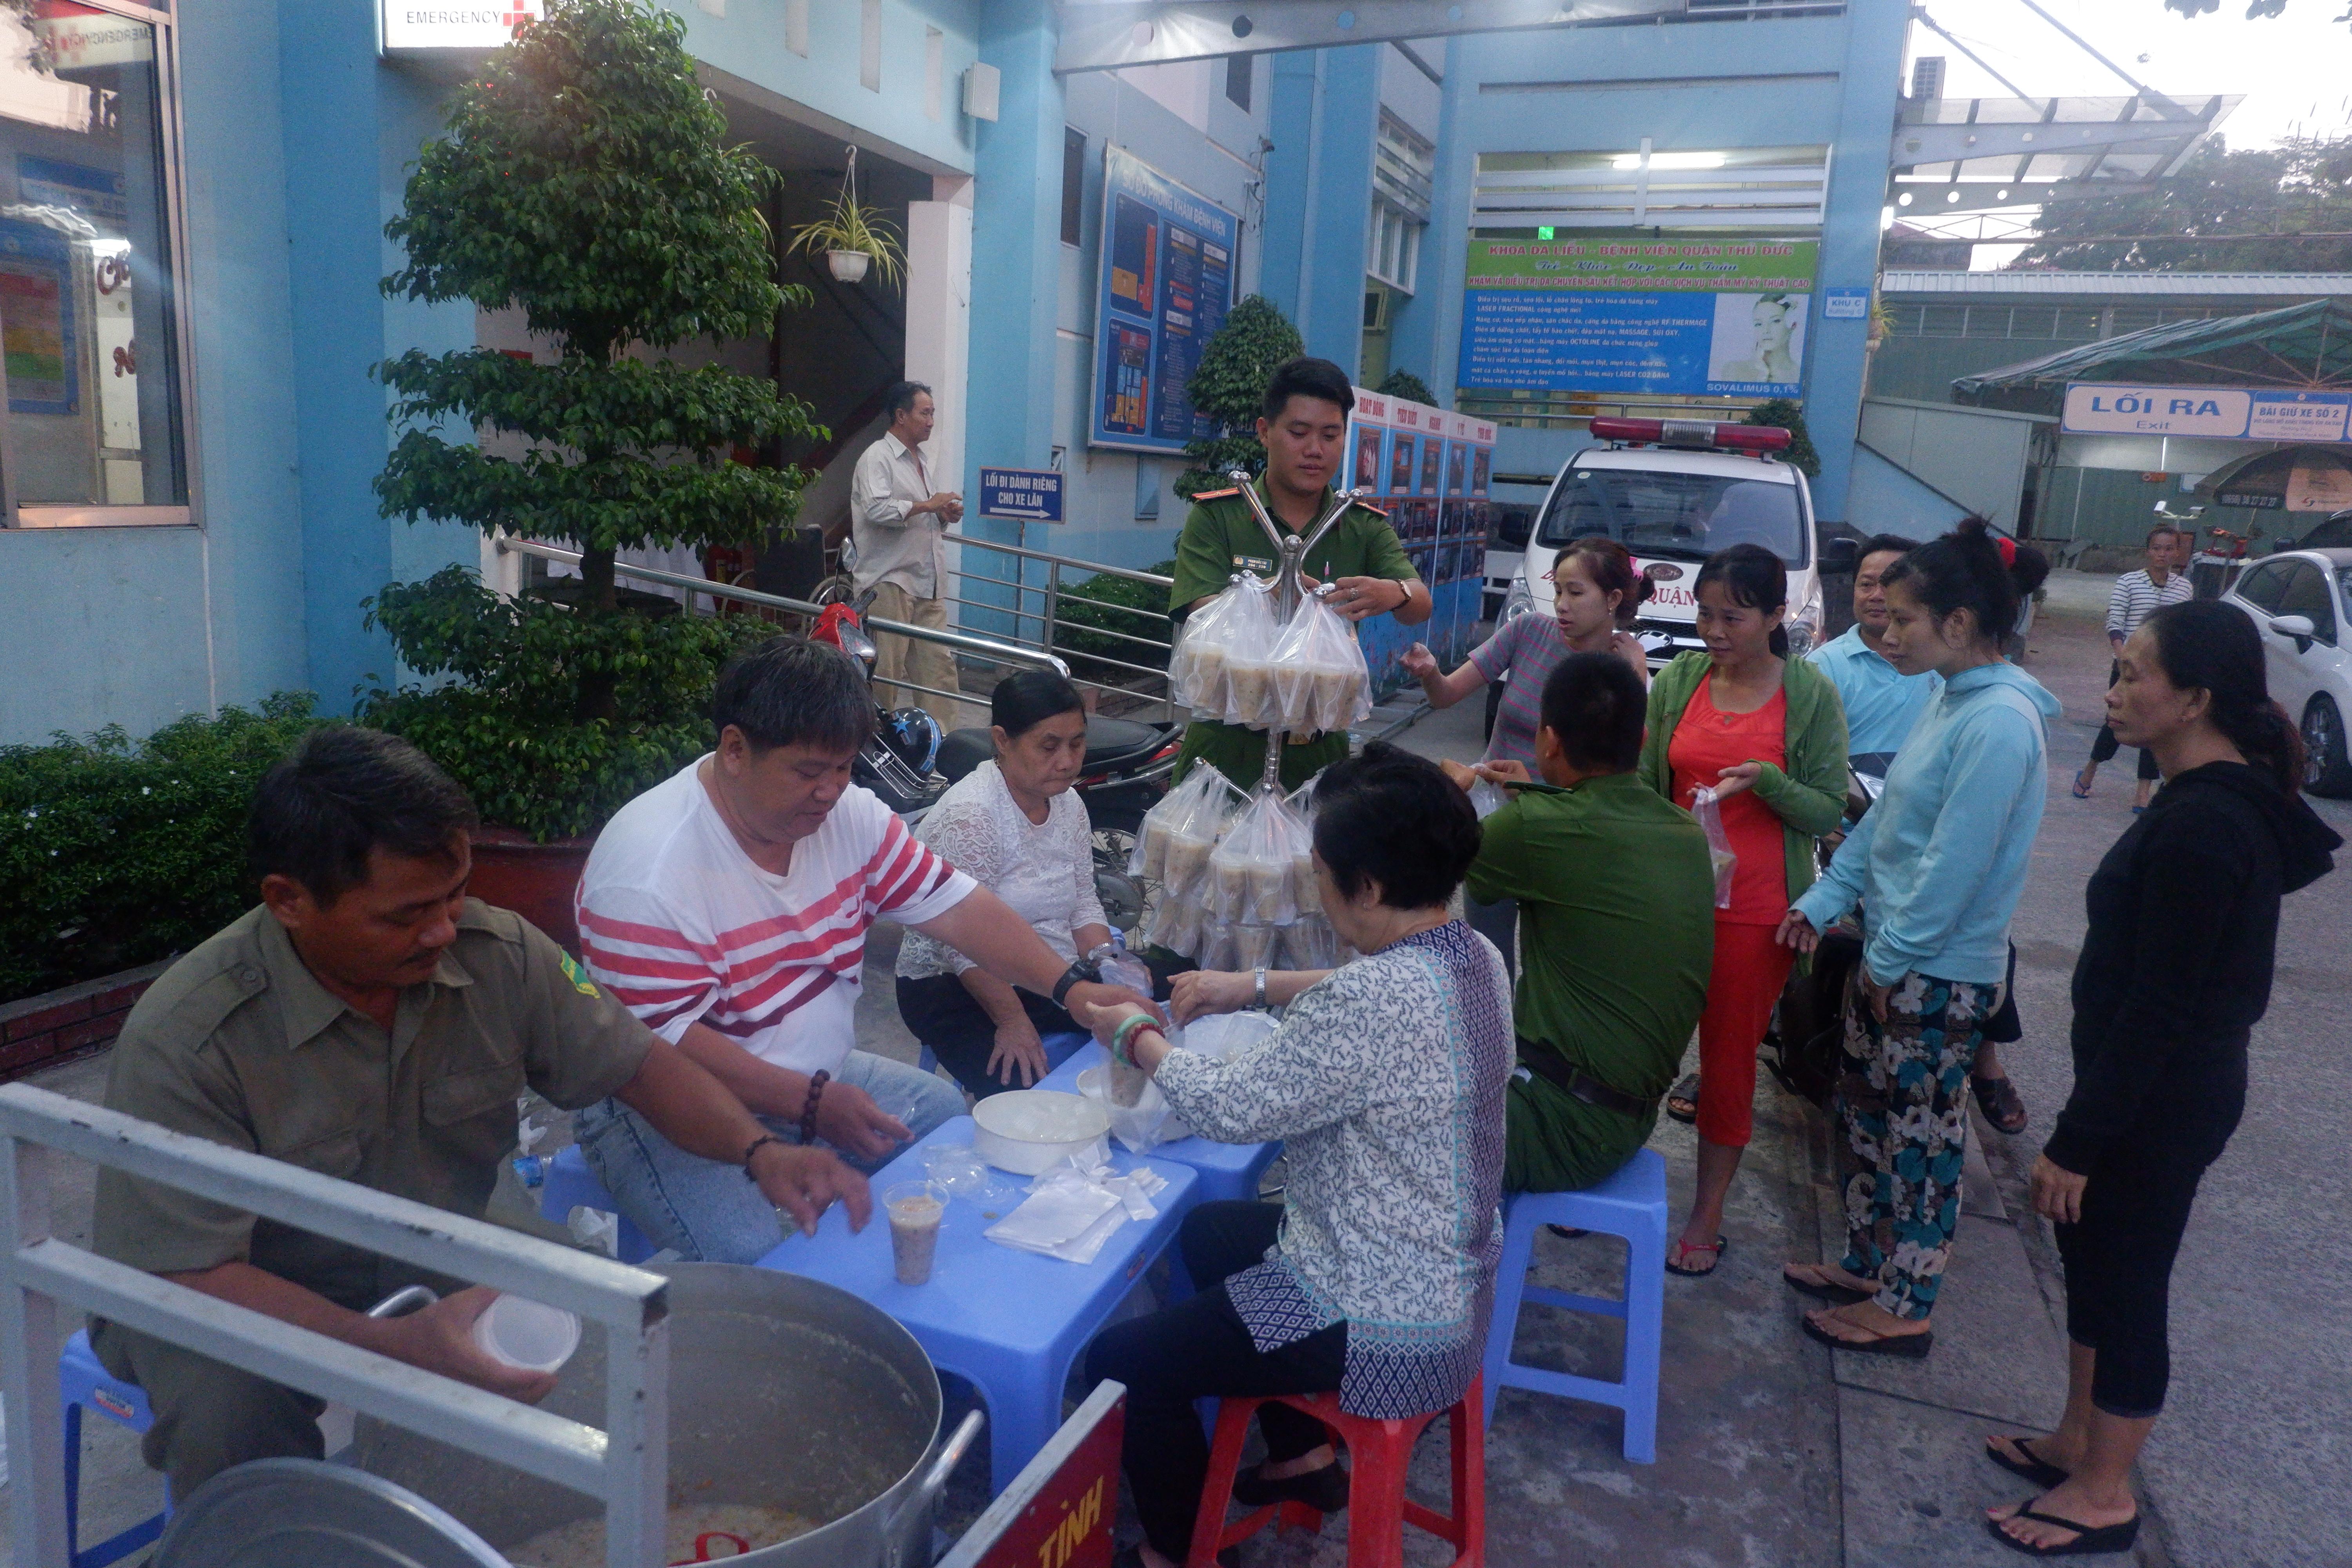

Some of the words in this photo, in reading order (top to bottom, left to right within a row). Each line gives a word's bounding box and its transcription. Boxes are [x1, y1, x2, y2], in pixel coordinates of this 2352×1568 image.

[407, 11, 500, 24] EMERGENCY
[1489, 245, 1526, 255] KHOA
[1530, 245, 1549, 255] DA
[1553, 240, 1585, 255] LIỄU
[1600, 243, 1639, 257] BỆNH
[1644, 243, 1677, 257] VIỆN
[1682, 243, 1722, 257] QUẬN
[1727, 242, 1756, 256] THỦ
[1761, 243, 1794, 256] ĐỨC
[1468, 274, 1491, 286] KHÁM
[1493, 274, 1502, 286] VÀ
[1504, 273, 1523, 286] ĐIỀU
[1525, 277, 1537, 289] TRỊ
[1539, 277, 1550, 286] DA
[1552, 274, 1583, 287] CHUYÊN
[1584, 275, 1601, 287] SÂU
[1602, 274, 1618, 287] KẾT
[1621, 276, 1637, 289] HỢP
[1639, 276, 1653, 287] VỚI
[1654, 276, 1671, 287] CÁC
[1673, 278, 1692, 289] DỊCH
[1693, 278, 1705, 290] VỤ
[1708, 274, 1731, 288] THẨM
[1733, 276, 1746, 288] MỸ
[1748, 276, 1761, 288] KỸ
[1763, 276, 1790, 290] THUẬT
[1791, 279, 1809, 288] CAO
[1707, 383, 1770, 393] SOVALIMUS
[1773, 385, 1798, 394] 0,1%
[1359, 397, 1372, 418] HOẠT
[1372, 397, 1384, 420] ĐỘNG
[2091, 392, 2152, 414] LỐI
[2169, 398, 2221, 416] RA
[2259, 405, 2276, 416] BÃI
[2279, 407, 2298, 416] GIỮ
[2299, 408, 2313, 417] XE
[2316, 406, 2330, 418] SỐ
[2332, 410, 2339, 418] 2
[2136, 419, 2170, 430] Exit
[985, 472, 998, 487] LỐI
[999, 476, 1008, 488] ĐI
[1009, 475, 1031, 490] DÀNH
[1033, 476, 1057, 492] RIÊNG
[998, 492, 1014, 505] CHO
[1015, 493, 1025, 506] XE
[1027, 492, 1043, 508] LĂN
